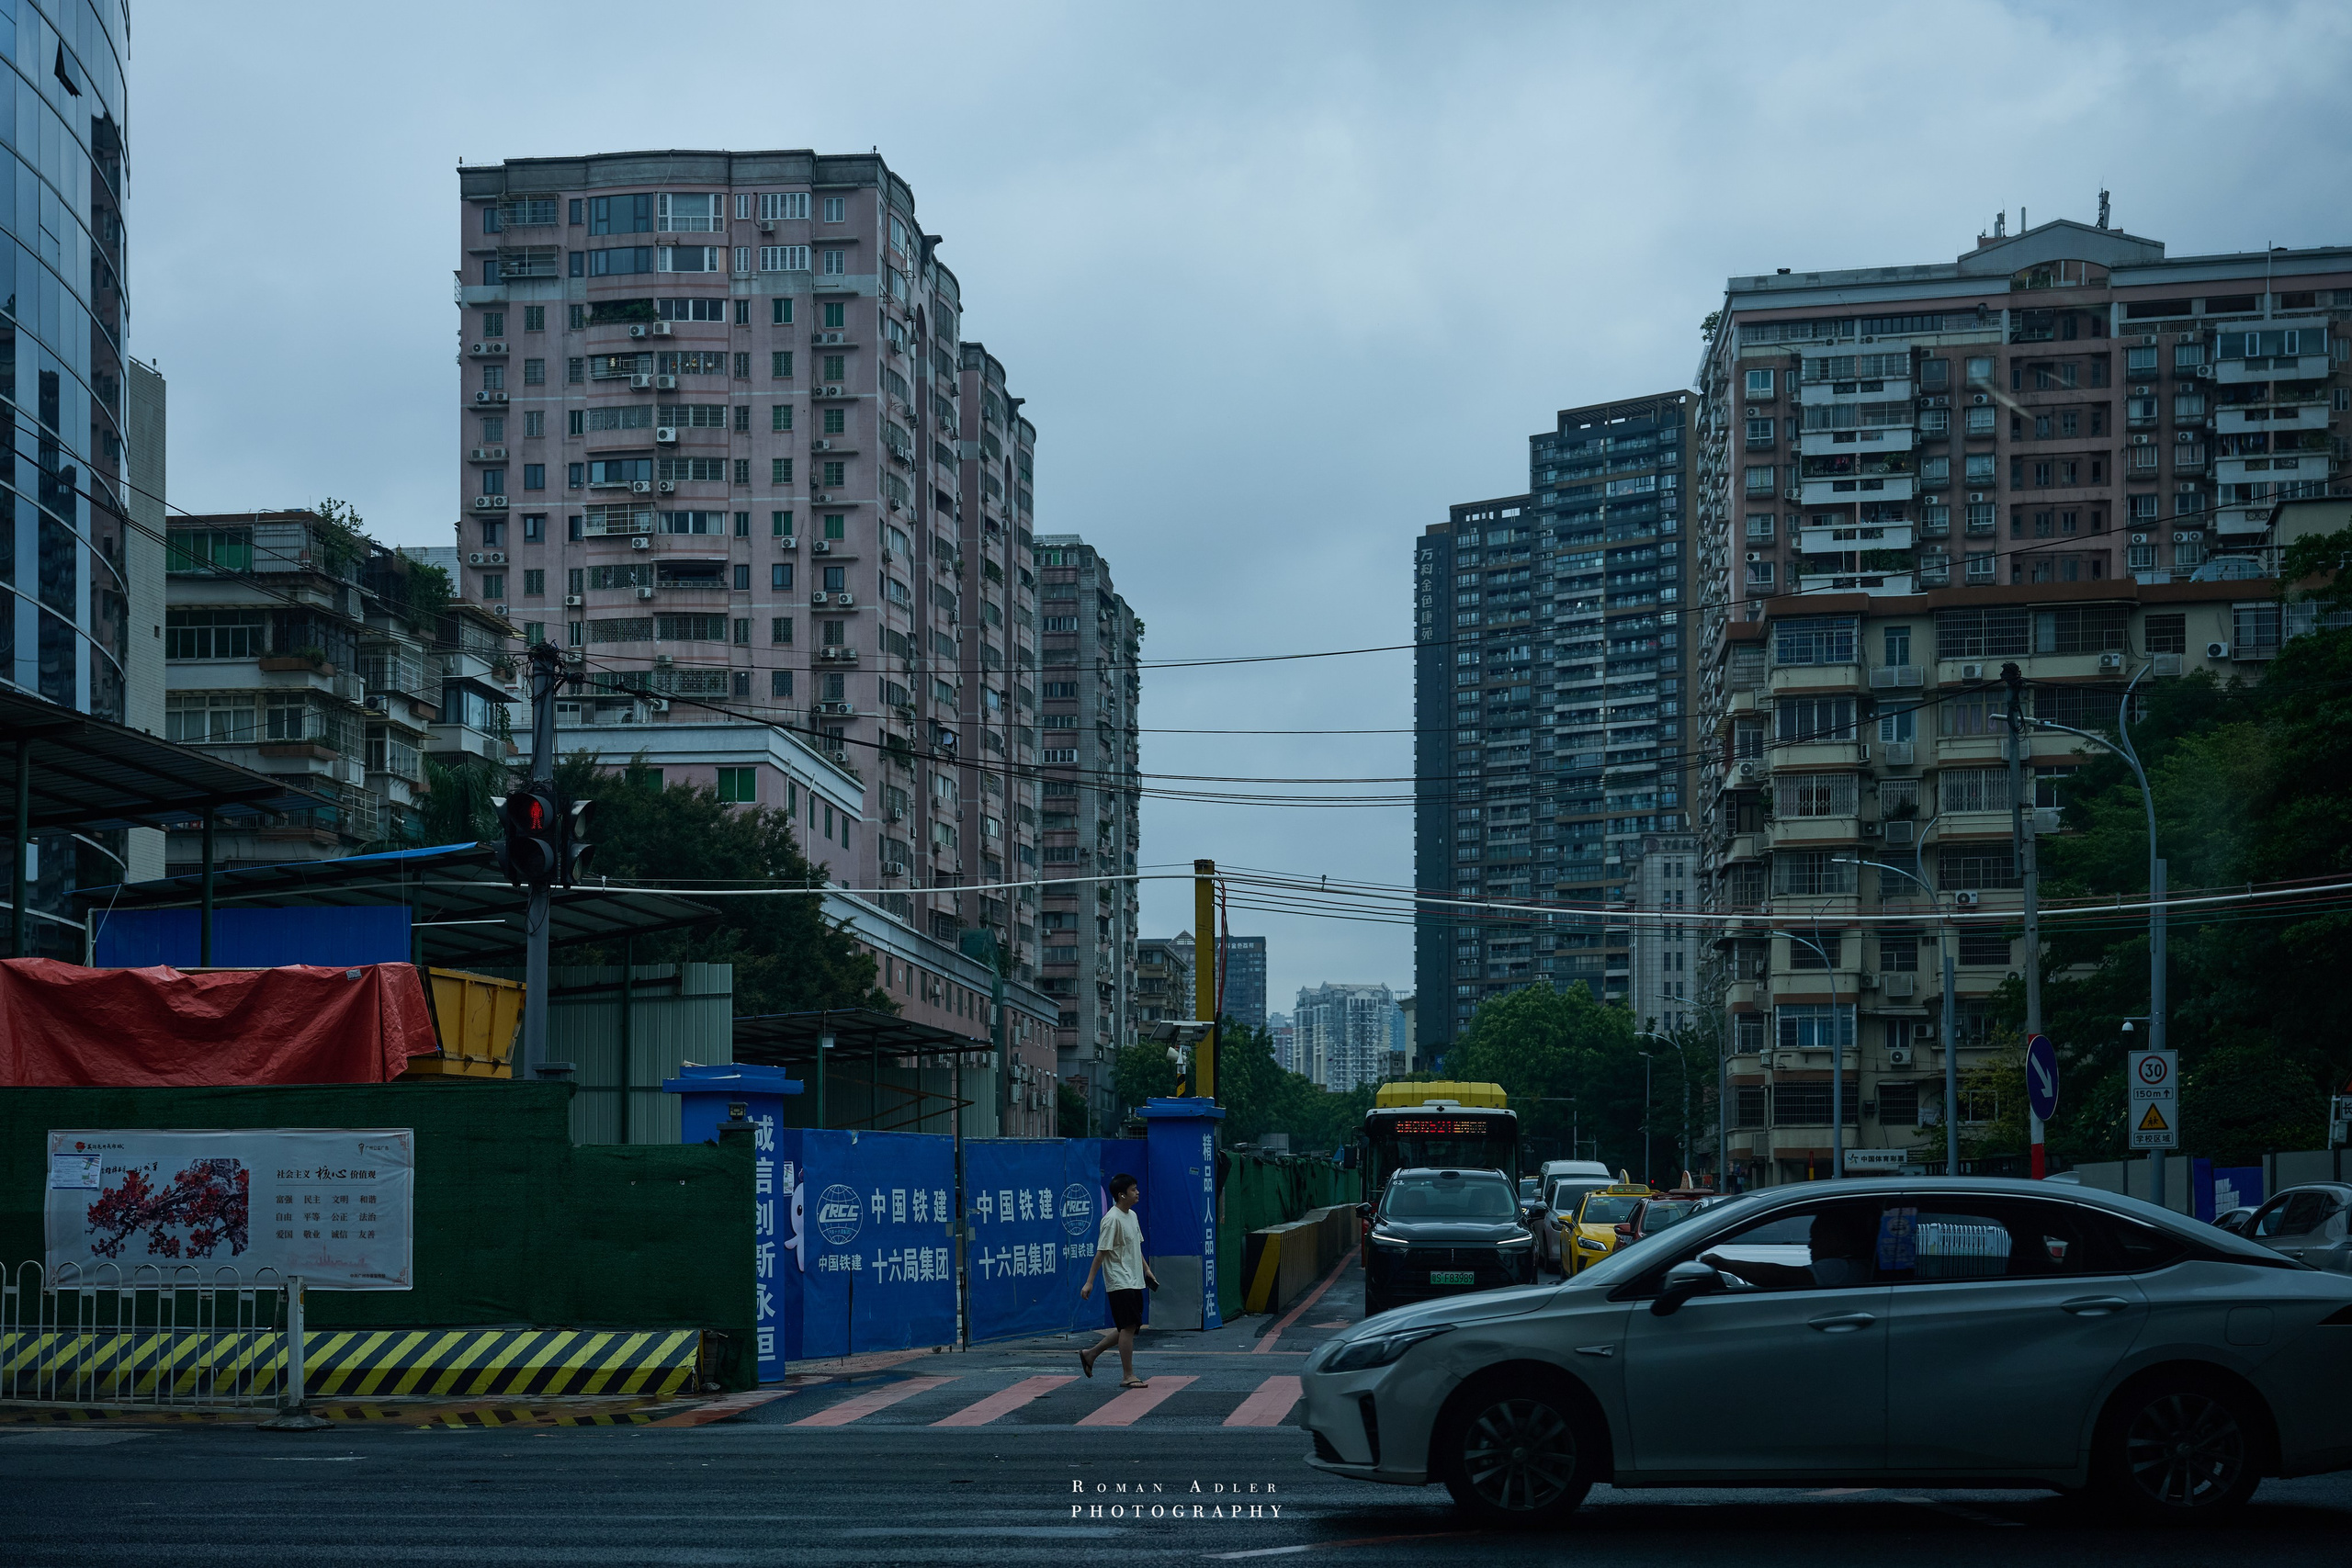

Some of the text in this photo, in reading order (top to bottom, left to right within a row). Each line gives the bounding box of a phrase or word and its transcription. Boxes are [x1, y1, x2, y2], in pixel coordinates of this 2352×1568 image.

[1420, 548, 1433, 640] 万科金色康苑
[2145, 1064, 2162, 1077] 30
[2136, 1134, 2171, 1144] 学校区域
[276, 1195, 377, 1204] 富强 民主 文明 和谐
[871, 1188, 947, 1224] 中国铁建
[977, 1188, 1054, 1224] 中国铁建
[276, 1213, 377, 1222] 自由 平等 公正 法治
[820, 1203, 859, 1223] CRCC
[1062, 1201, 1091, 1217] CRCC
[276, 1230, 375, 1239] 爱国 敬业 诚信 友善
[1203, 1134, 1216, 1318] 精品人品同在
[1062, 1243, 1094, 1259] 中国铁建
[819, 1254, 862, 1272] 中国铁建
[872, 1247, 949, 1283] 十六局集团
[978, 1243, 1056, 1280] 十六局集团
